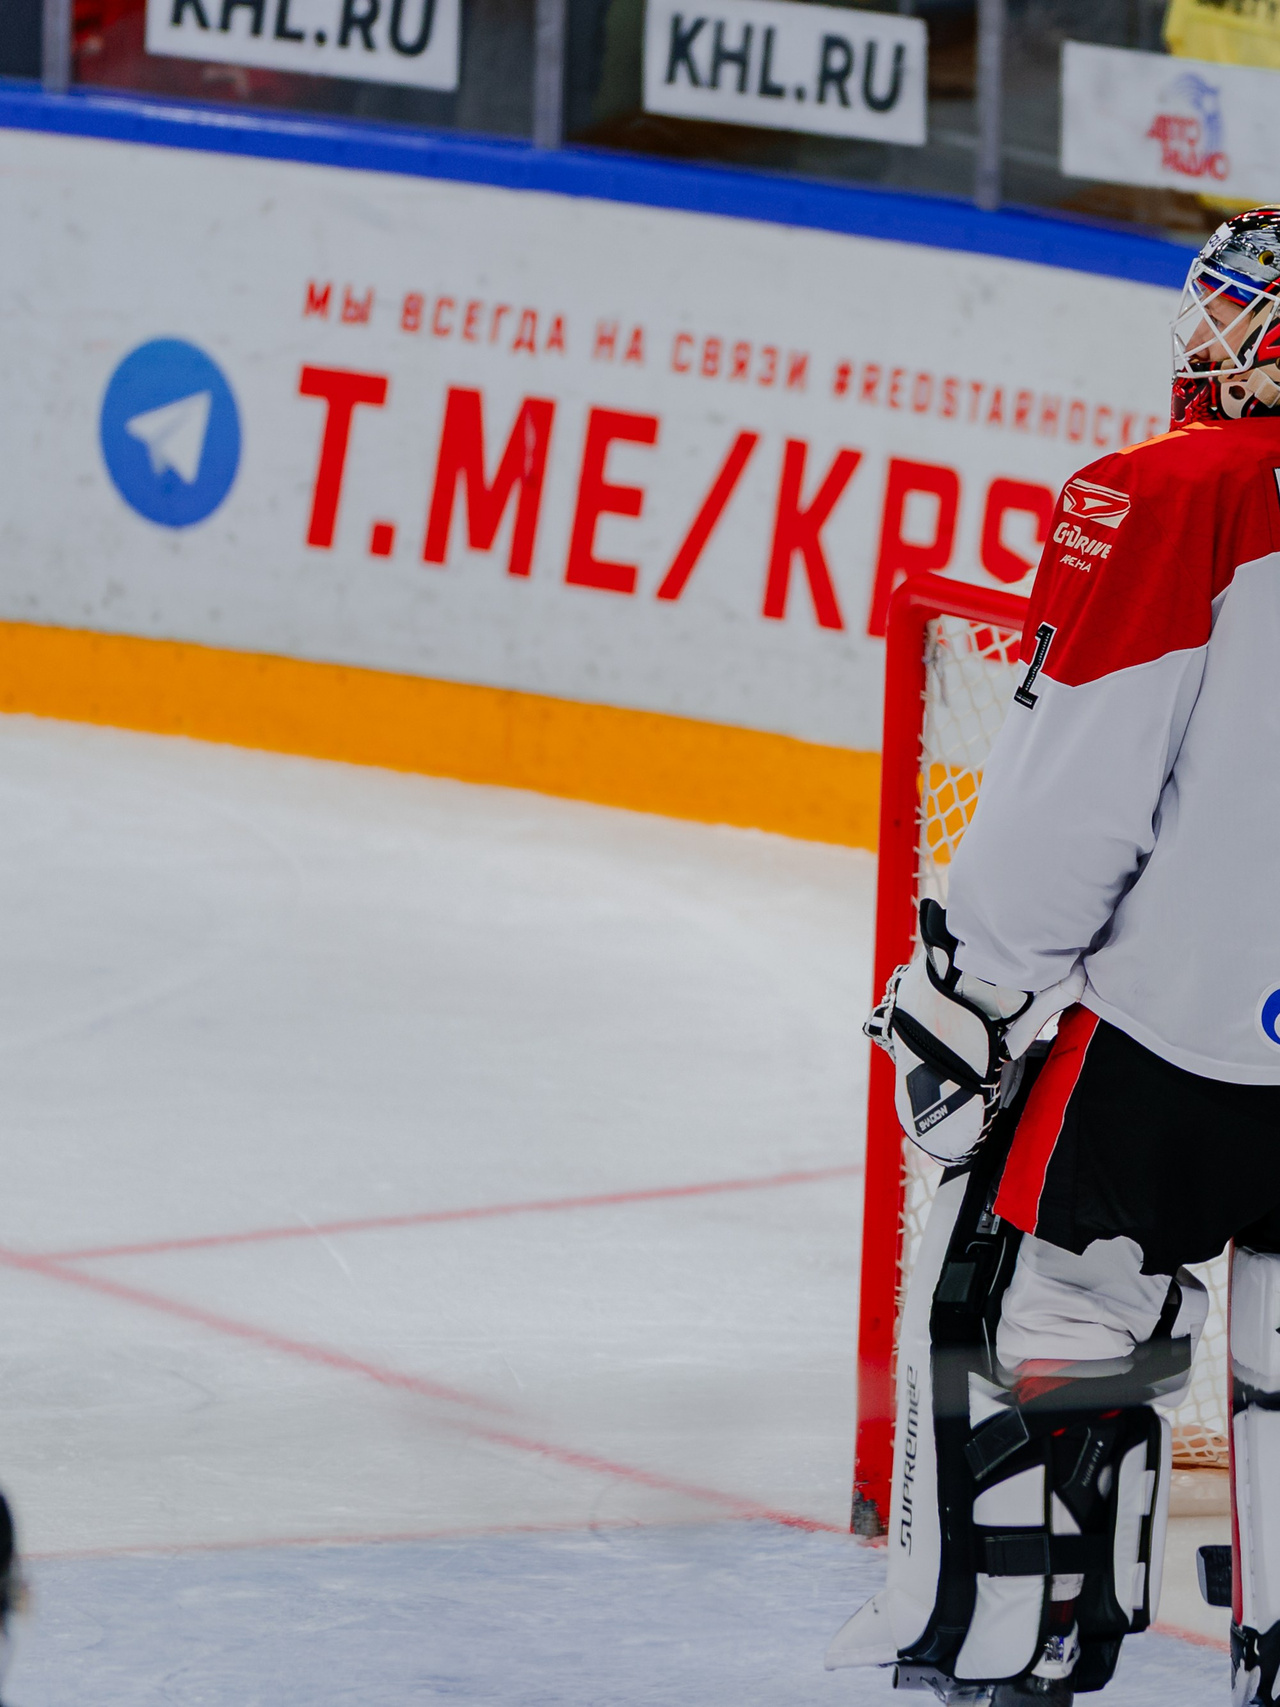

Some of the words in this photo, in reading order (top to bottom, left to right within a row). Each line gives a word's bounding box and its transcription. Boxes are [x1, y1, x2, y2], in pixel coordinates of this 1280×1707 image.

[665, 13, 905, 112] KHL.RU
[303, 280, 373, 326] МЫ
[401, 292, 566, 356] ВСЕГДА
[594, 320, 645, 369] НА
[672, 333, 811, 391] СВЯЗИ
[1014, 621, 1057, 710] 1
